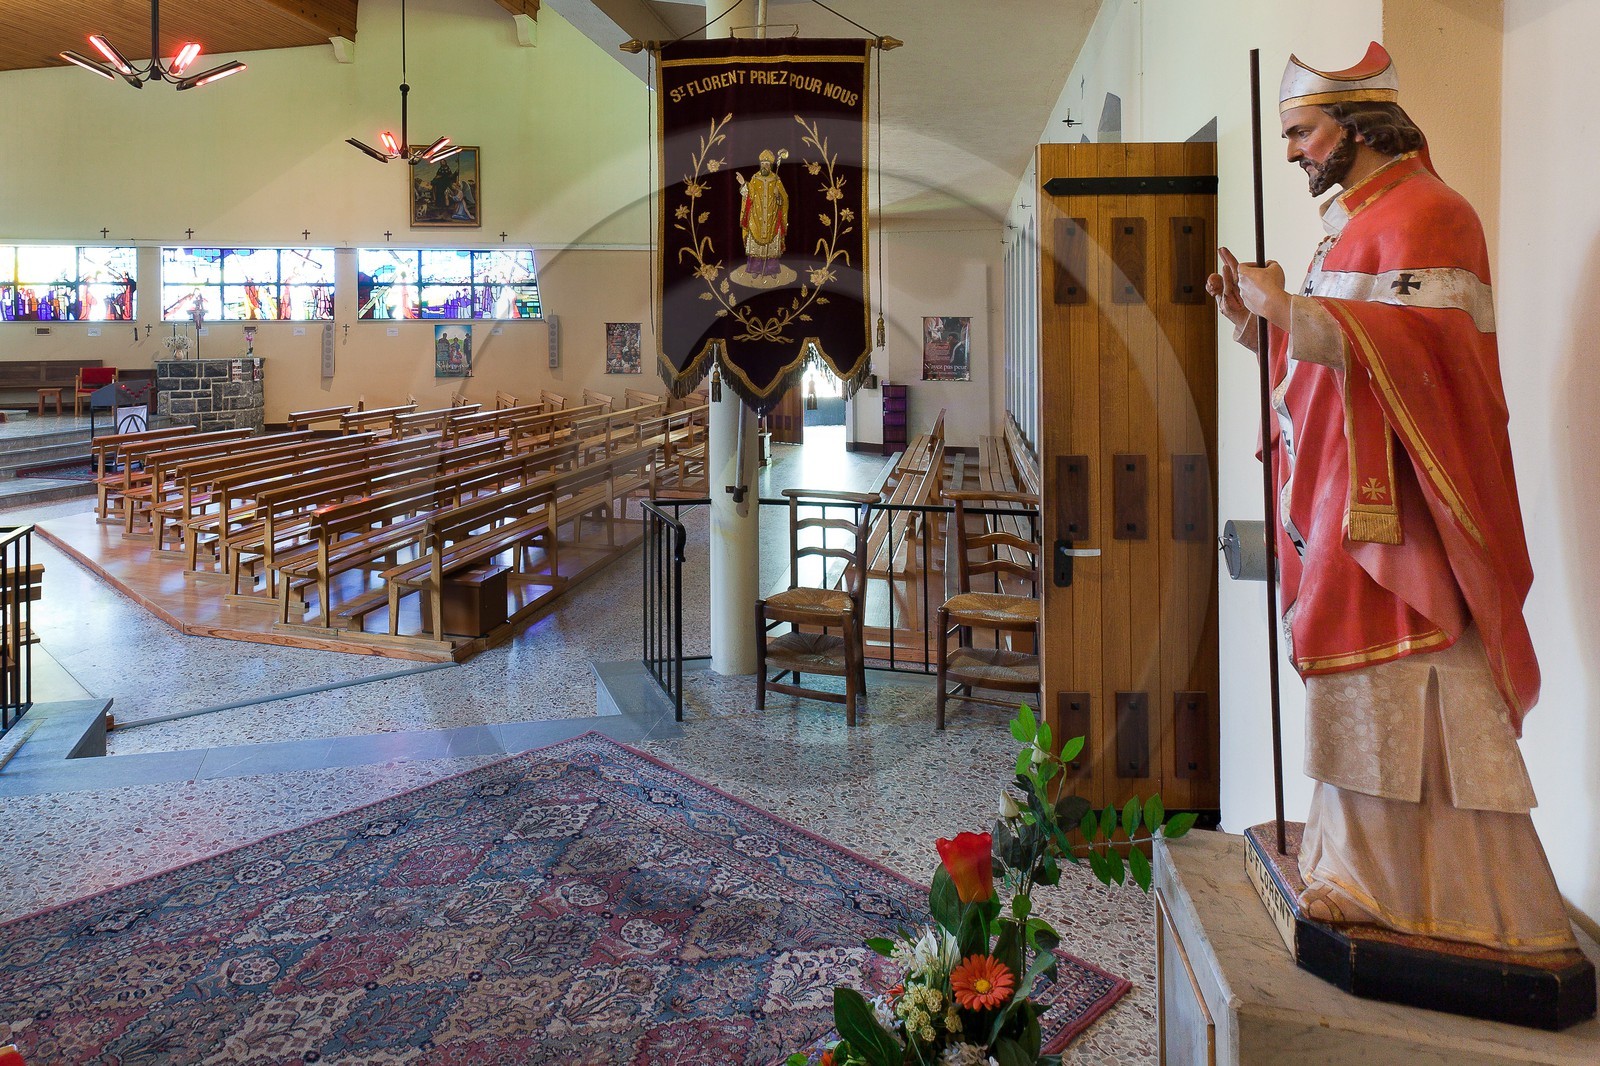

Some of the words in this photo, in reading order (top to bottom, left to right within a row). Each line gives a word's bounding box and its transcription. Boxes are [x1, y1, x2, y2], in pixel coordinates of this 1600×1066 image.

[687, 69, 746, 97] FLORENT
[750, 69, 788, 85] PRIEZ
[789, 73, 822, 95] POUR
[823, 82, 859, 107] NOUS
[1254, 855, 1291, 928] FLORENT
